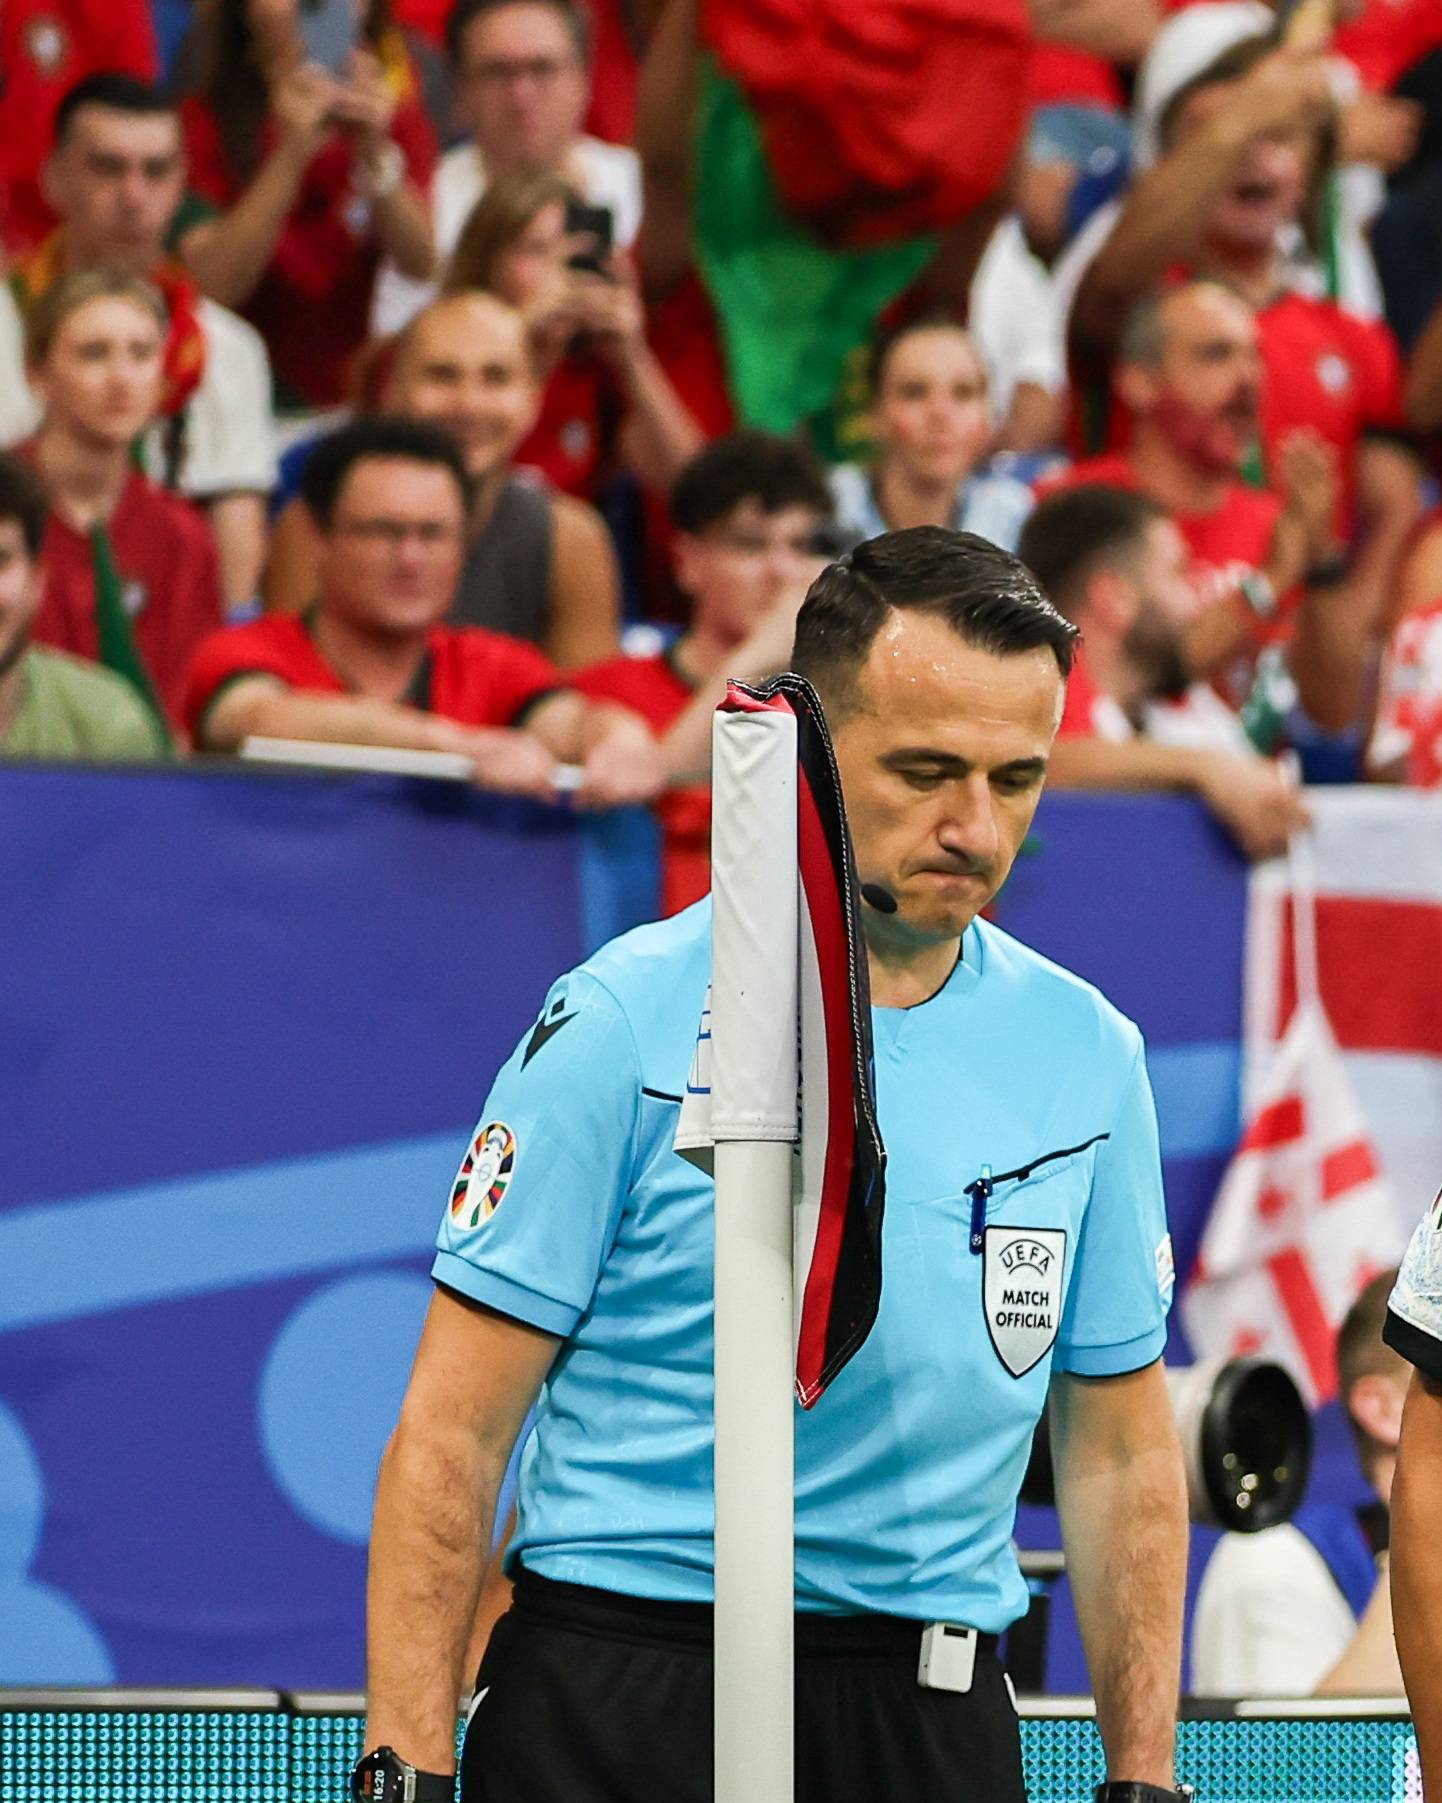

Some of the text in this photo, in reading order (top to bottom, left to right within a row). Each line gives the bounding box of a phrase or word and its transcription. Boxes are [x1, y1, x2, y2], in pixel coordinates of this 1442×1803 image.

[1002, 1244, 1050, 1273] UEFA
[1002, 1289, 1049, 1307] MATCH
[995, 1311, 1053, 1329] OFFICIAL
[373, 1769, 385, 1801] 16:20
